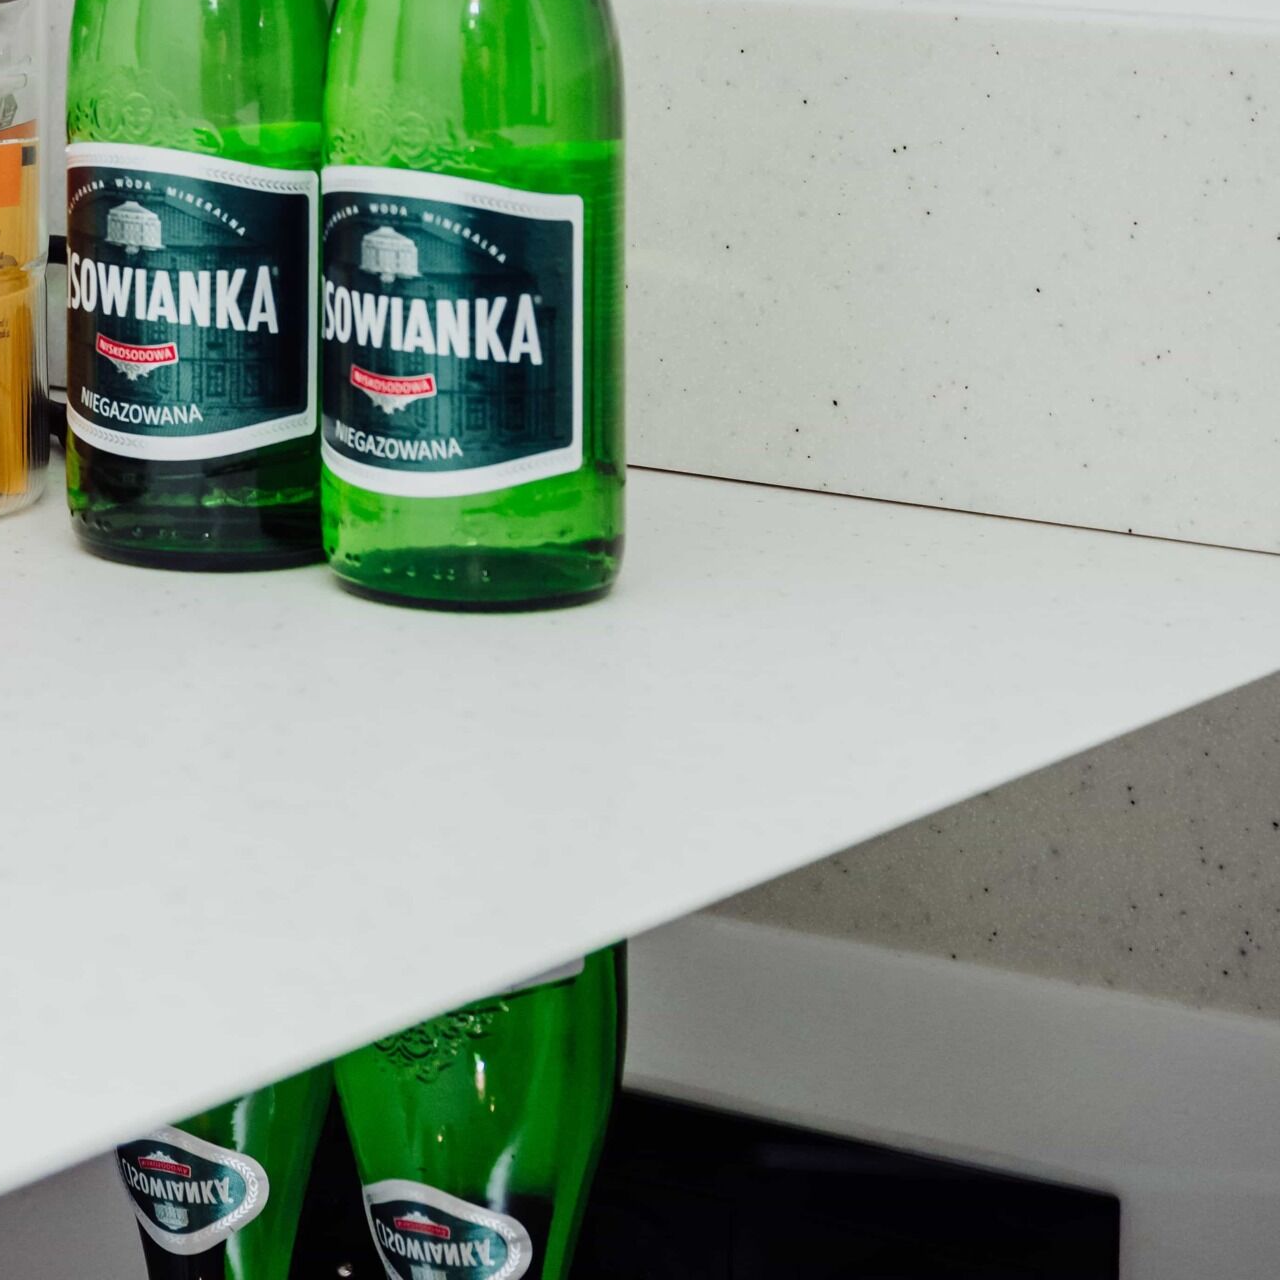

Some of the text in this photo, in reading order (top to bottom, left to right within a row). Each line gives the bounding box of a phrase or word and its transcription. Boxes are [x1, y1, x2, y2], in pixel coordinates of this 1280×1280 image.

[114, 178, 152, 191] WODA
[166, 186, 246, 237] MINERALNA
[368, 202, 408, 216] WODA
[422, 211, 507, 264] MINERALNA
[99, 339, 172, 362] NISKOSODOWA
[80, 386, 204, 426] NIEGAZOWANA
[335, 419, 463, 461] NIEGAZOWANA
